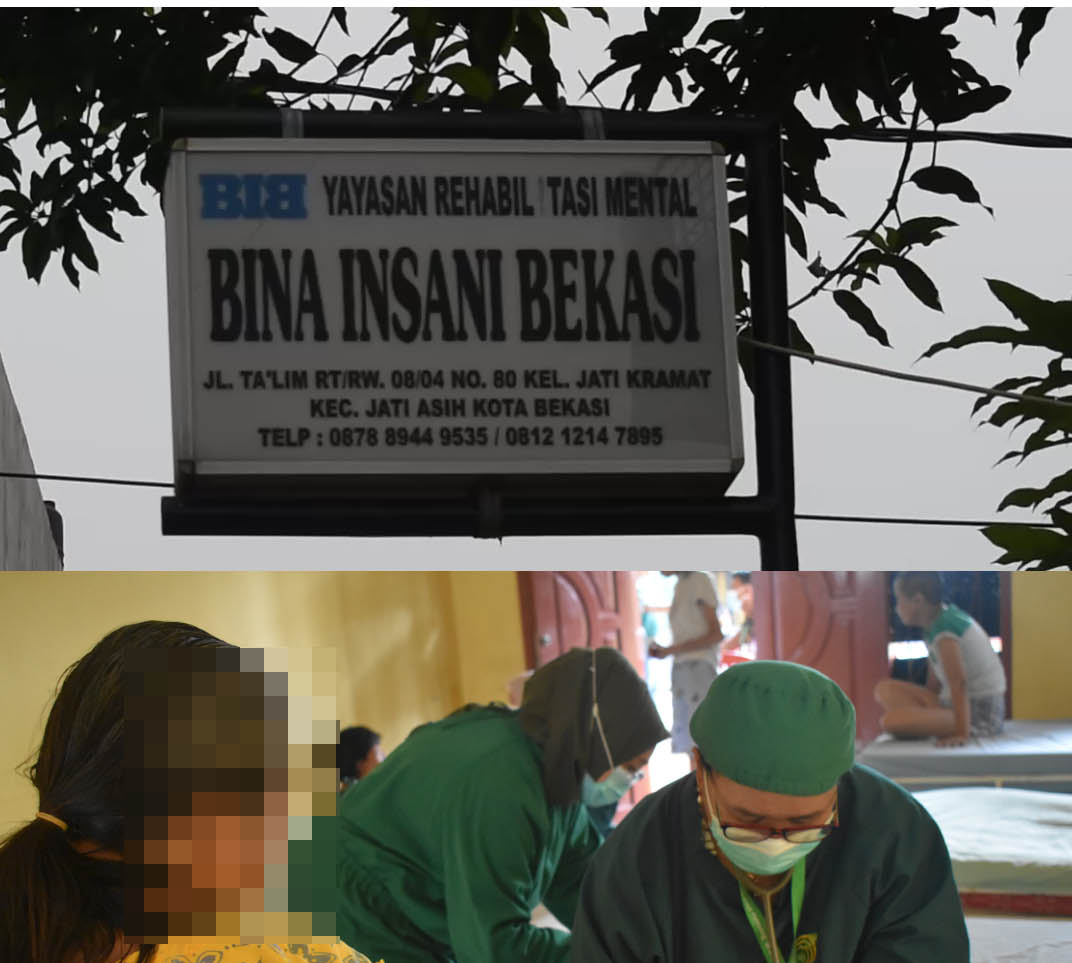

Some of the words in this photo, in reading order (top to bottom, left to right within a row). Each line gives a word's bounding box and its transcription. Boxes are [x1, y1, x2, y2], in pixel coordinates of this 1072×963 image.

[322, 175, 427, 216] YAYASAN
[605, 176, 698, 218] MENTAL
[207, 247, 329, 343] BINA
[339, 247, 506, 344] INSANI
[516, 247, 701, 344] BEKASI
[203, 370, 233, 390] JL.
[315, 370, 385, 390] RT/RW.
[391, 370, 445, 390] 08/04
[451, 370, 487, 390] NO.
[493, 370, 517, 390] 80
[524, 370, 570, 390] KEL.
[576, 369, 619, 390] JATI
[626, 369, 712, 389] KRAMAT
[310, 398, 359, 418] KEC.
[365, 398, 409, 418] JATI
[417, 398, 466, 418] ASIH
[473, 398, 528, 418] KOTA
[534, 398, 610, 418] BEKASI
[329, 427, 378, 447] 0878
[385, 427, 434, 447] 8944
[439, 427, 488, 447] 9535
[505, 426, 554, 446] 0812
[561, 426, 609, 446] 1214
[614, 426, 663, 446] 7895
